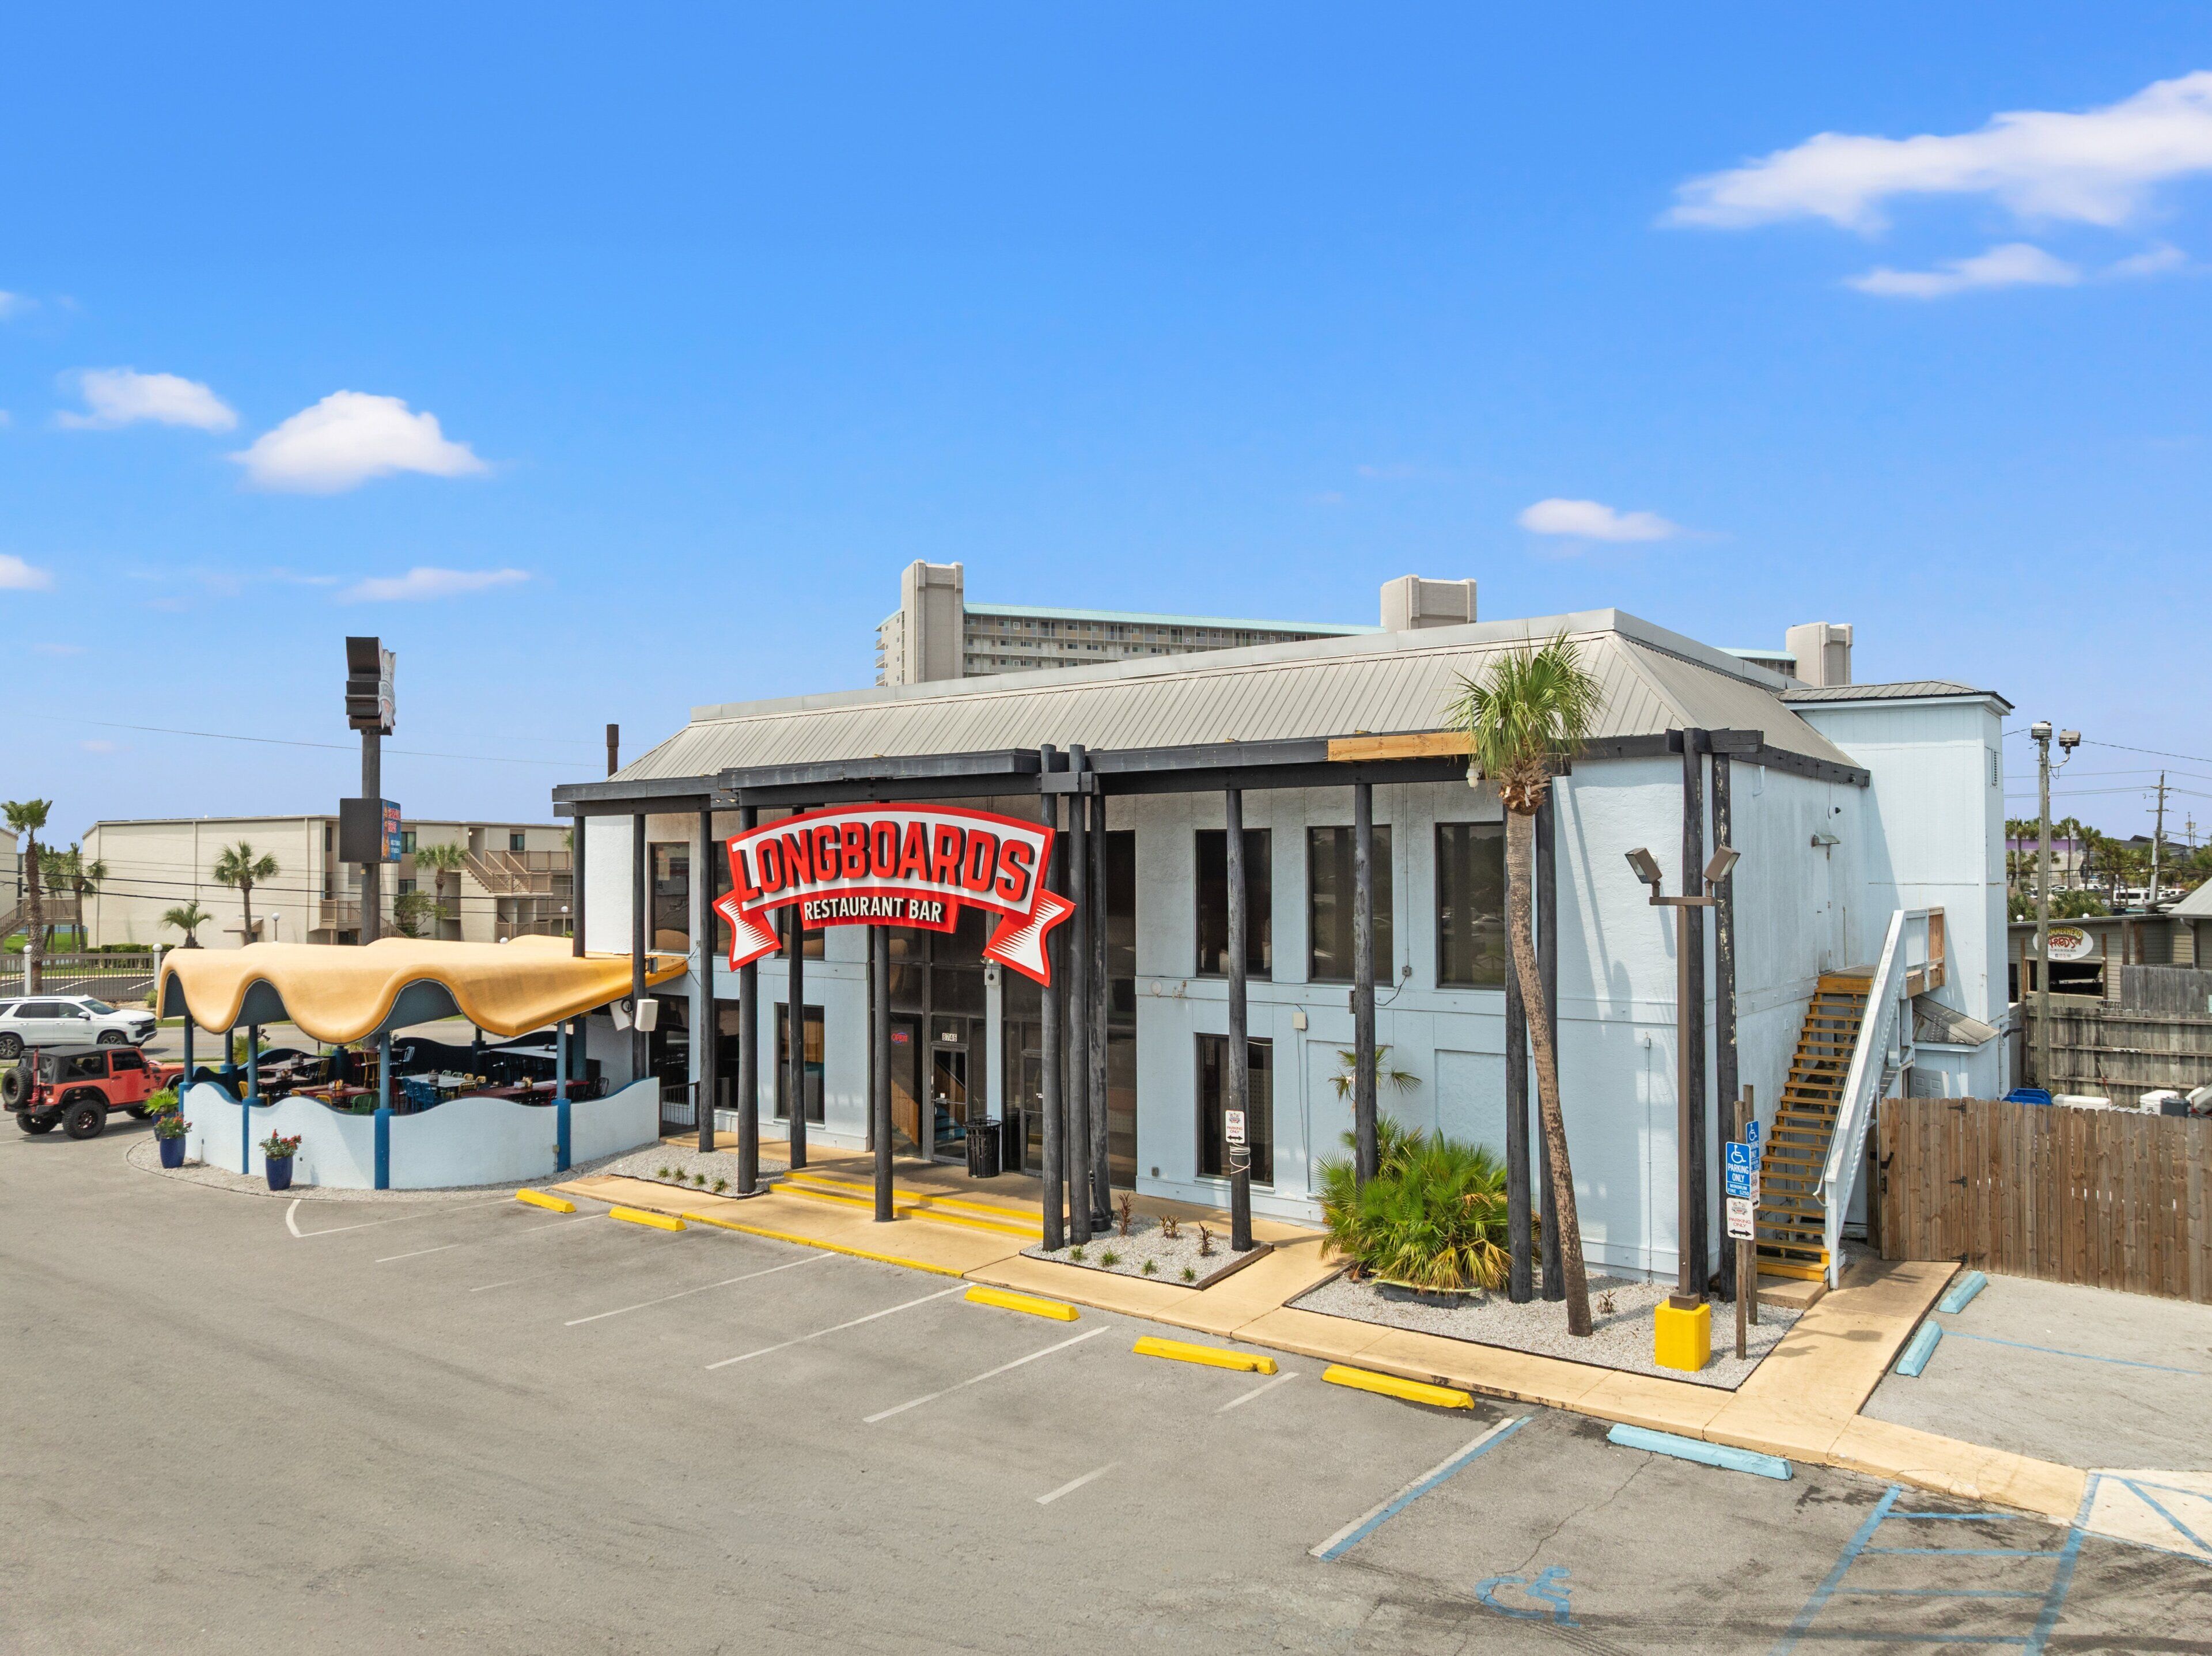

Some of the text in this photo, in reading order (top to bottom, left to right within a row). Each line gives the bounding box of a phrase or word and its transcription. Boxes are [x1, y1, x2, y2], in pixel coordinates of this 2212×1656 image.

[732, 820, 1035, 903] LONGBOARDS
[804, 896, 943, 922] RESTAURANT BAR
[2048, 927, 2083, 939] AMMERHEAD
[891, 1034, 908, 1042] OPEN
[1728, 1163, 1749, 1174] PARKING
[1732, 1173, 1744, 1182] ONLY
